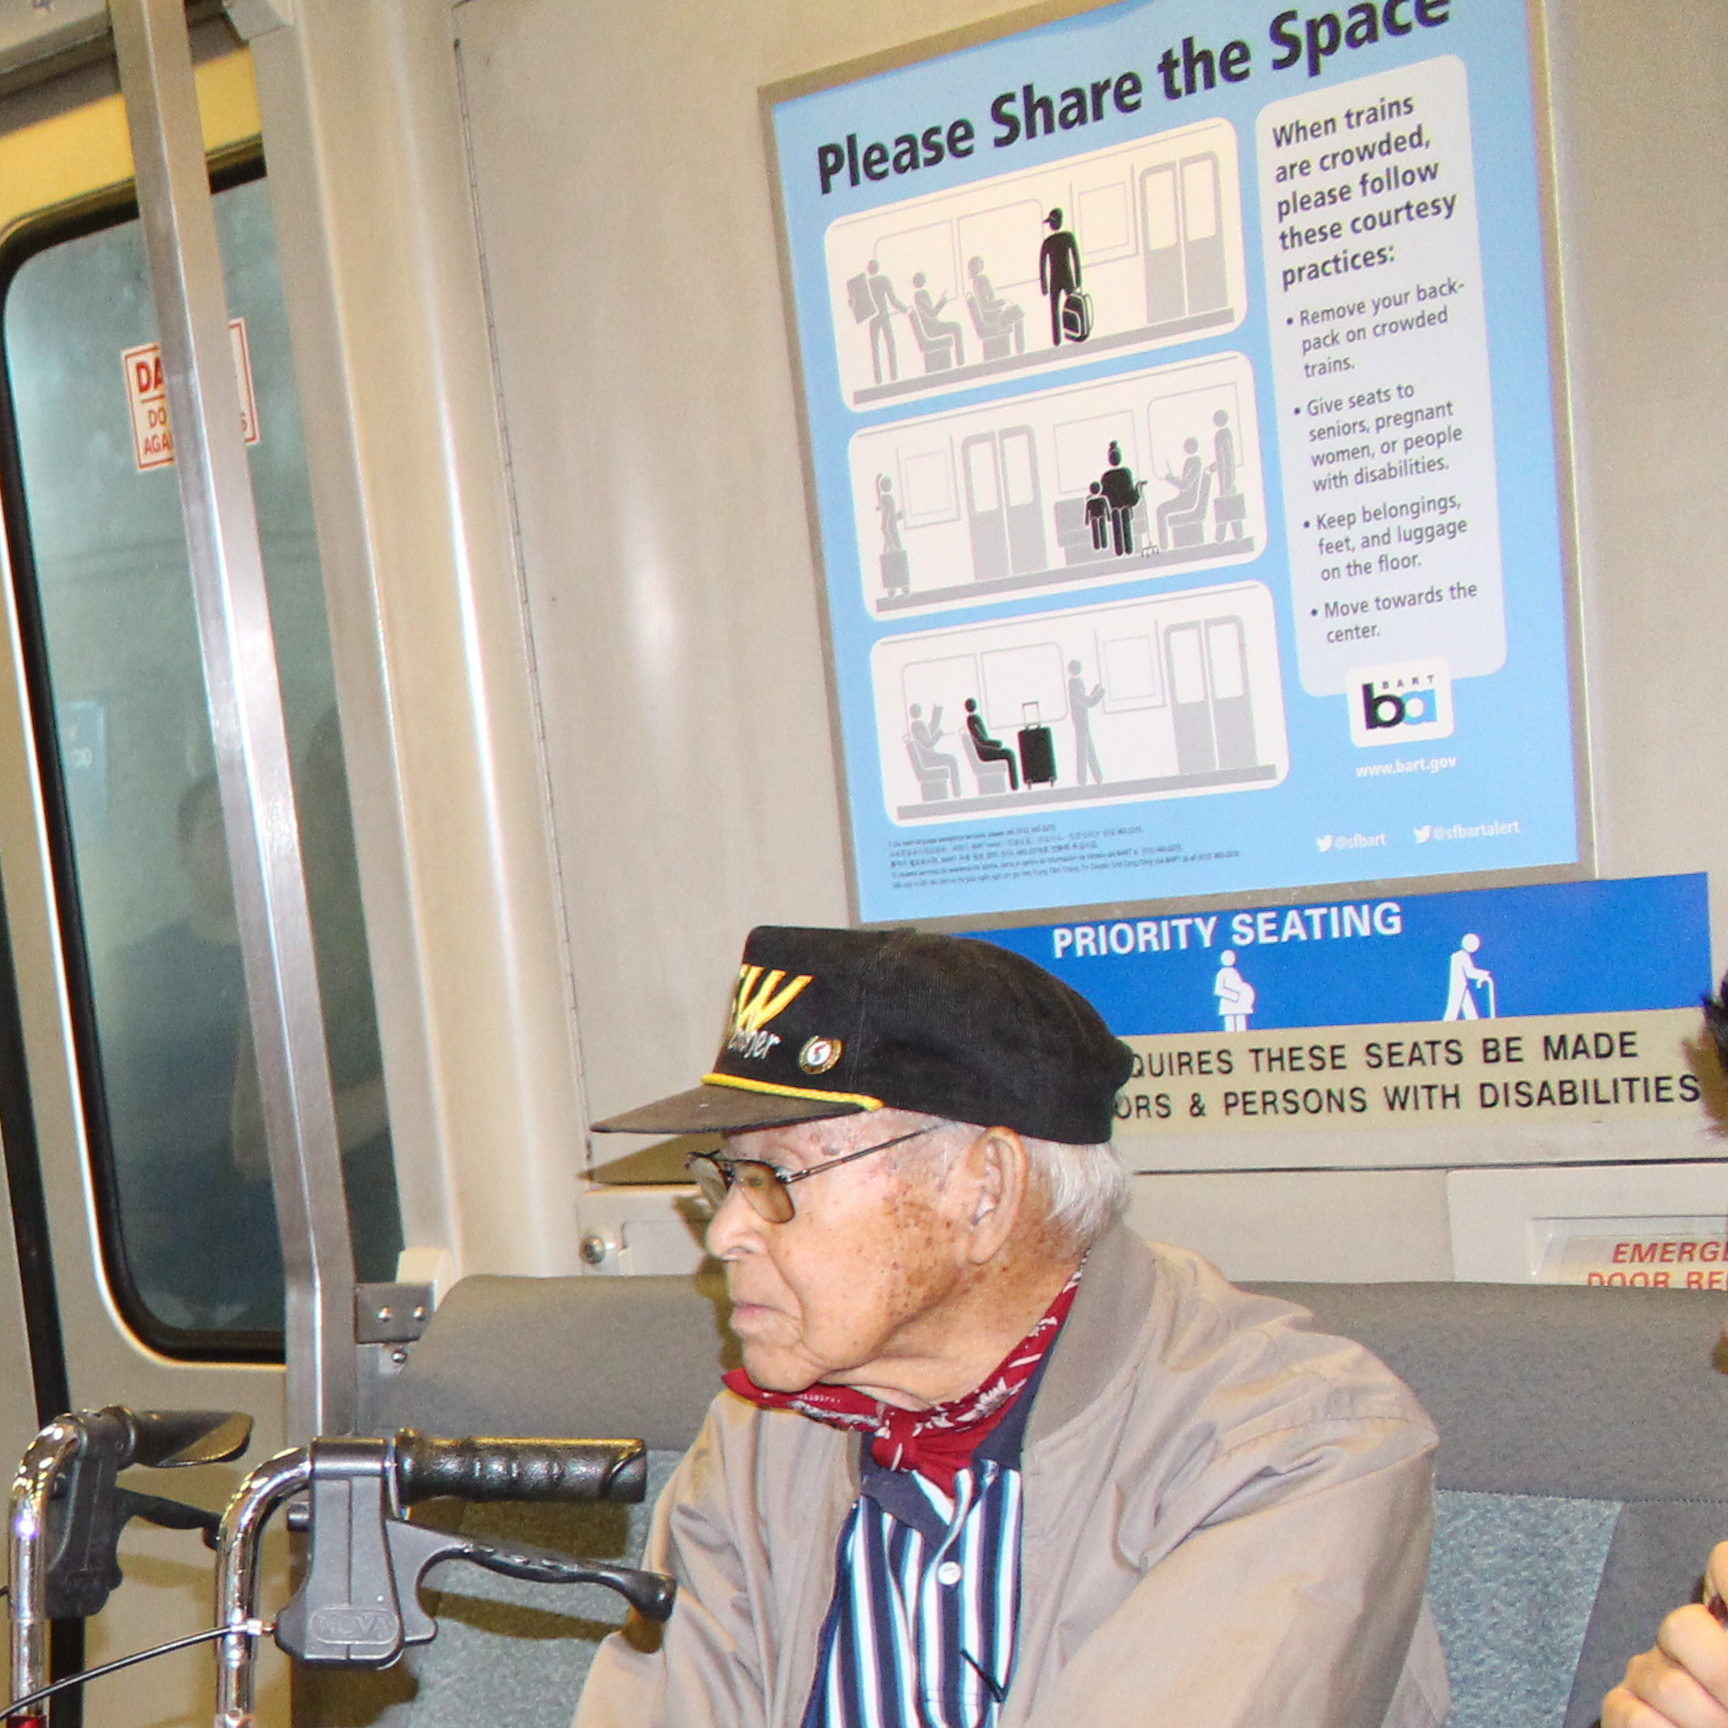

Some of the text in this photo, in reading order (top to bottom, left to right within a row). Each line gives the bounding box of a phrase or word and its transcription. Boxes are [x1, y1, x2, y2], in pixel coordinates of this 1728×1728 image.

[818, 0, 1451, 195] Please Share the Space
[1272, 96, 1414, 149] When trains
[1275, 124, 1431, 183] are crowded,
[1278, 162, 1439, 223] please follow
[1279, 193, 1457, 251] these courtesy
[1282, 246, 1395, 292] practices:
[1299, 277, 1465, 327] Remove your back-
[1301, 305, 1449, 356] pack on crowded
[1304, 355, 1356, 378] trains.
[148, 407, 167, 429] DO
[1307, 383, 1415, 417] Give seats to
[1309, 400, 1454, 443] seniors, pregnant
[1311, 425, 1463, 468] women, or people
[1313, 456, 1450, 492] with disabilities.
[1316, 494, 1462, 530] Keep belongings,
[1318, 519, 1468, 556] feet, and luggage
[1321, 553, 1422, 581] on the floor.
[1324, 581, 1478, 619] Move towards the
[1327, 623, 1381, 643] center.
[1382, 674, 1435, 690] BART
[1356, 756, 1458, 778] www.bart.gov
[1052, 901, 1403, 960] PRIORITY SEATING
[1248, 1043, 1347, 1072] THESE
[1365, 1038, 1464, 1069] SEATS
[1482, 1036, 1524, 1063] BE
[1543, 1030, 1639, 1061] MADE
[1190, 1092, 1206, 1118] &
[1224, 1087, 1367, 1116] PERSONS
[1383, 1082, 1461, 1111] WITH
[1479, 1073, 1701, 1109] DISABILITIES
[1687, 1270, 1728, 1290] RE
